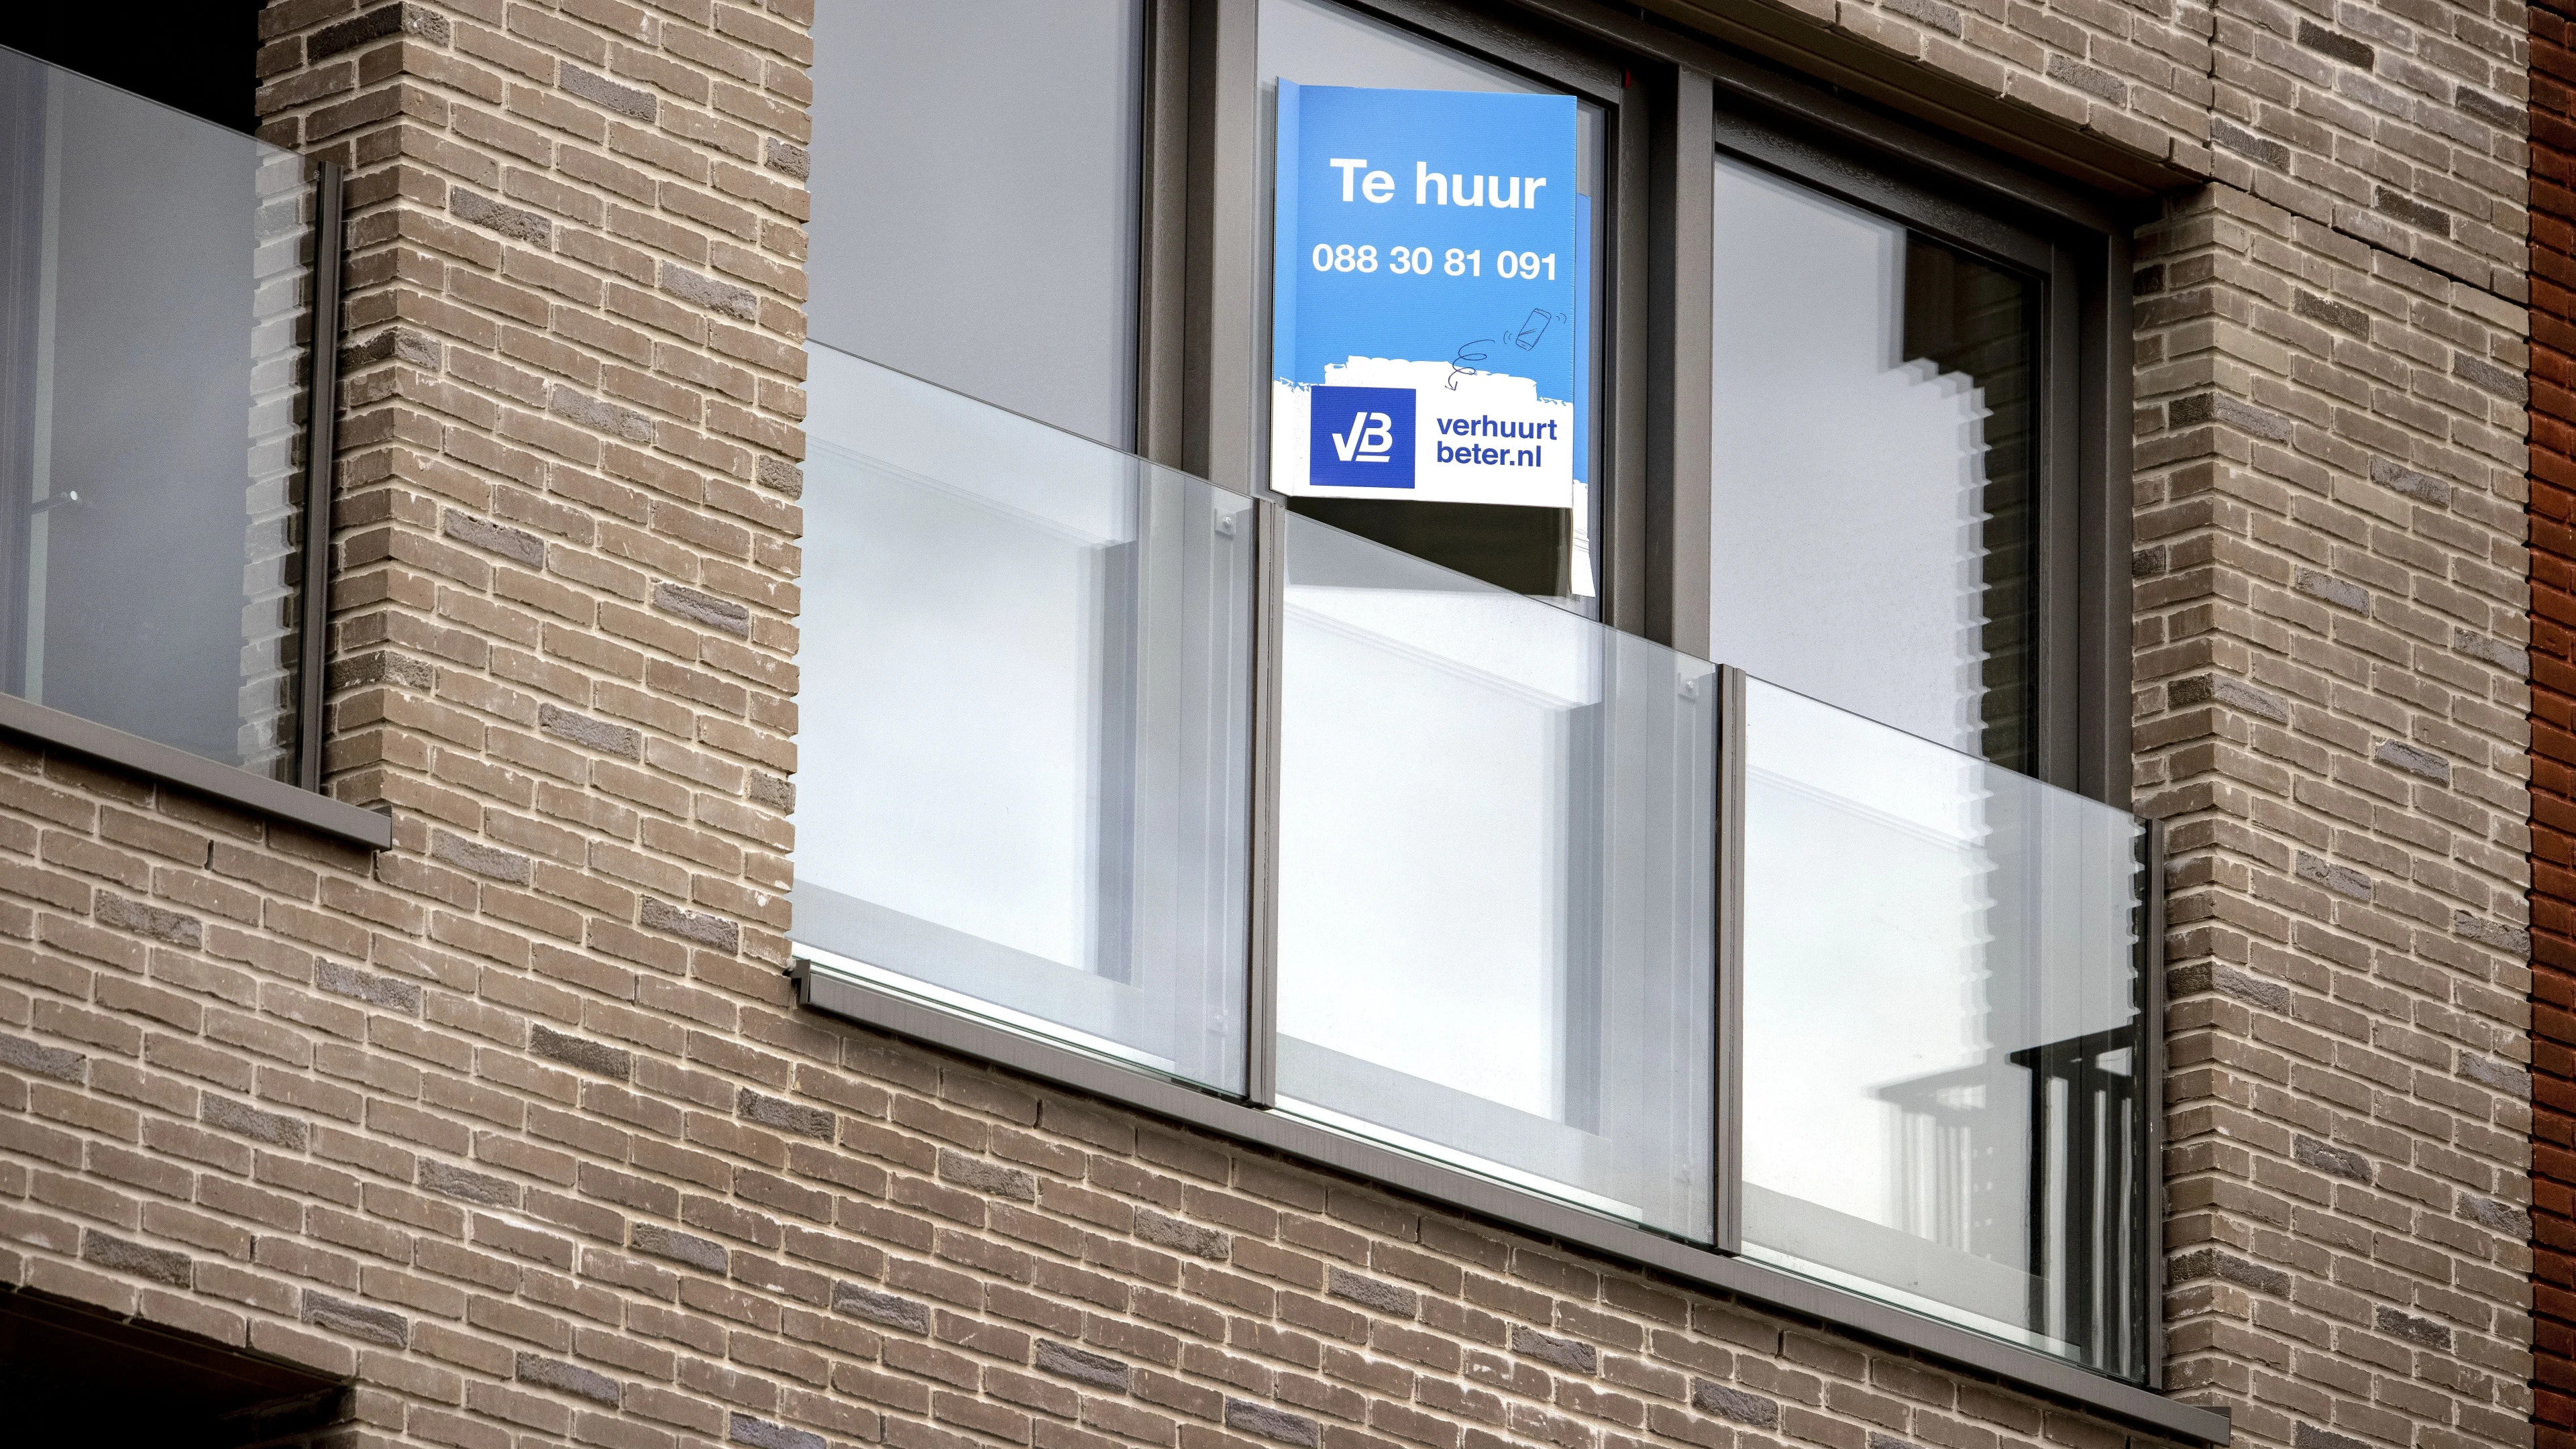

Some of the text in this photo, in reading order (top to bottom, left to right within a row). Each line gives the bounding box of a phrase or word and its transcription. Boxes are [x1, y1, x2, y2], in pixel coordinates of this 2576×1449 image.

[1330, 158, 1546, 209] Te huur
[1312, 244, 1556, 280] 088 30 81 091
[1436, 415, 1558, 440] verhuurt
[1436, 441, 1542, 466] beter.nl
